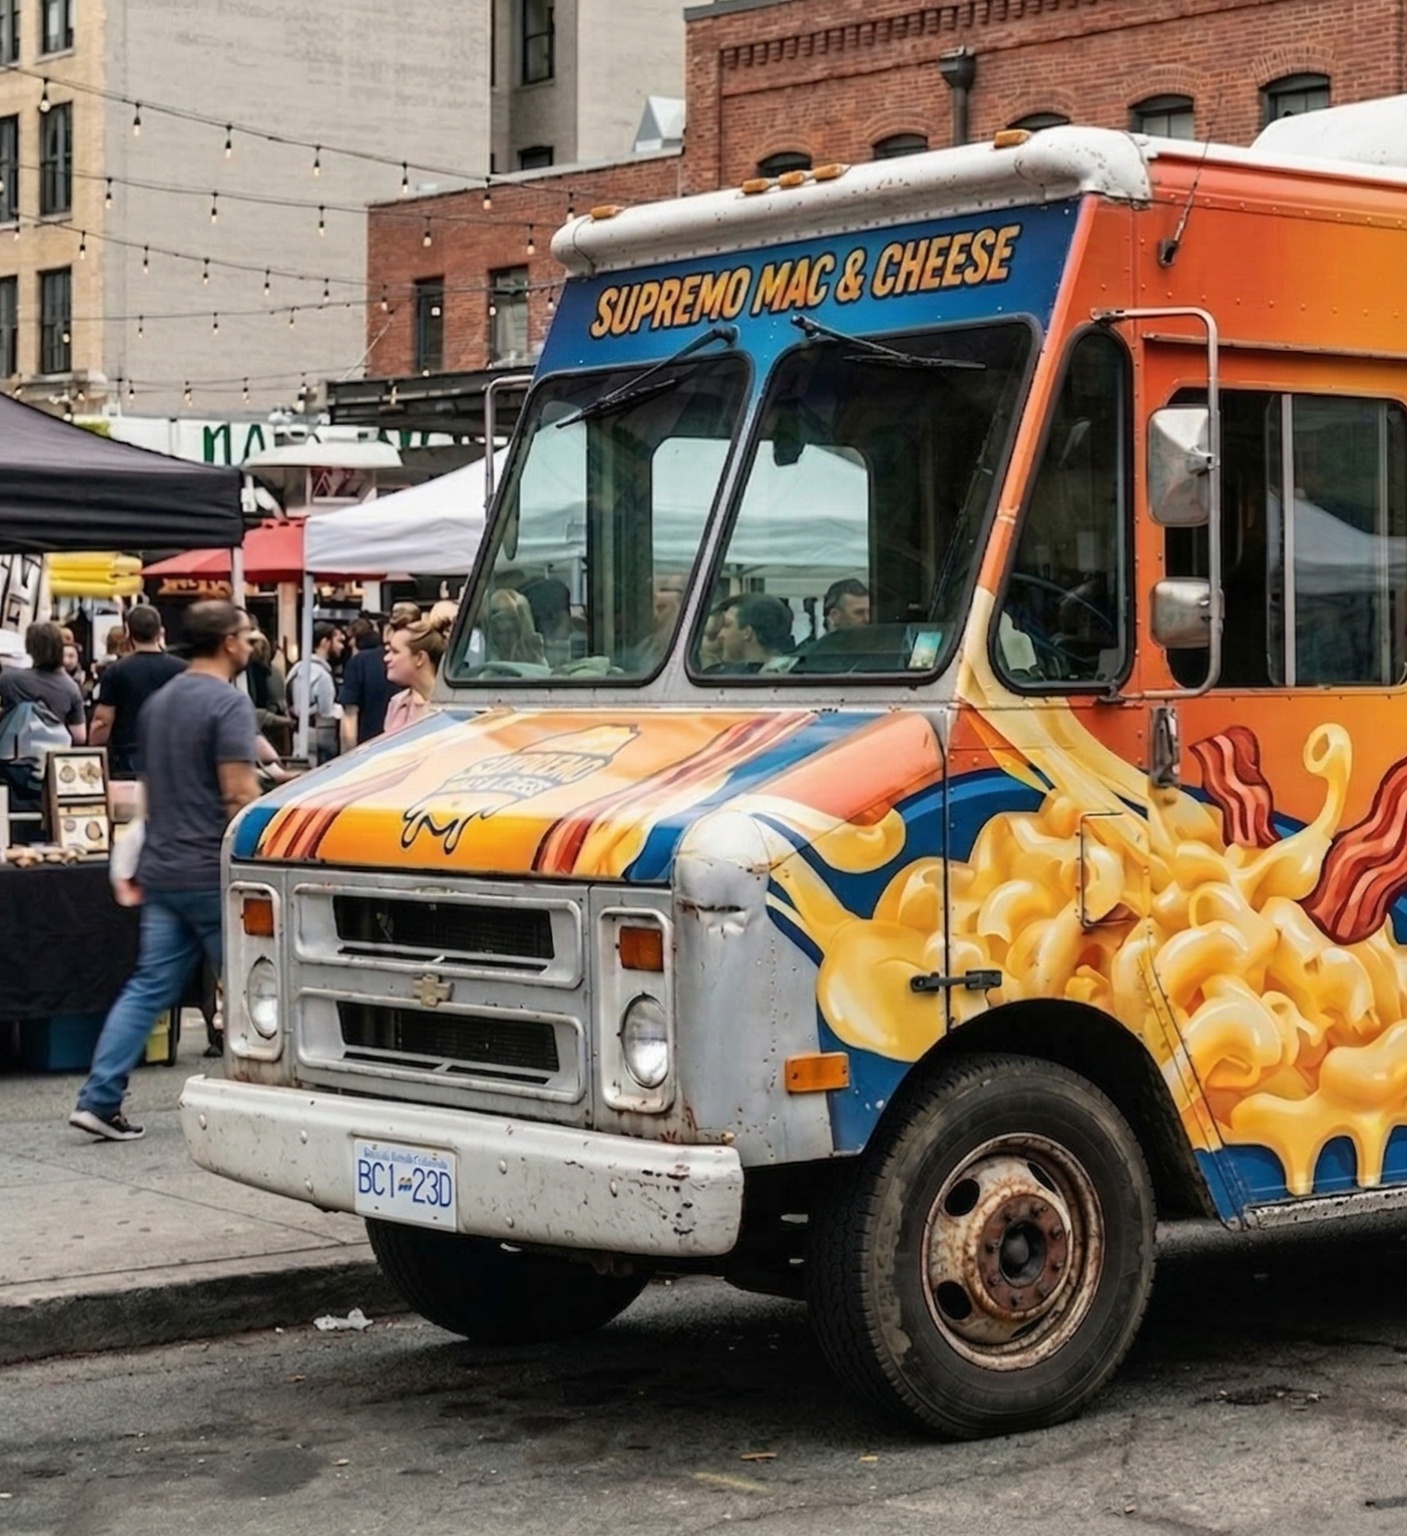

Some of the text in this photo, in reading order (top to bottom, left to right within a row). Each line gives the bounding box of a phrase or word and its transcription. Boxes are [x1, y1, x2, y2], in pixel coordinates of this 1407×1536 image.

[589, 224, 1022, 339] SUPREMO MAC & CHEESE
[358, 1159, 395, 1199] BC1
[412, 1167, 453, 1208] 23D
